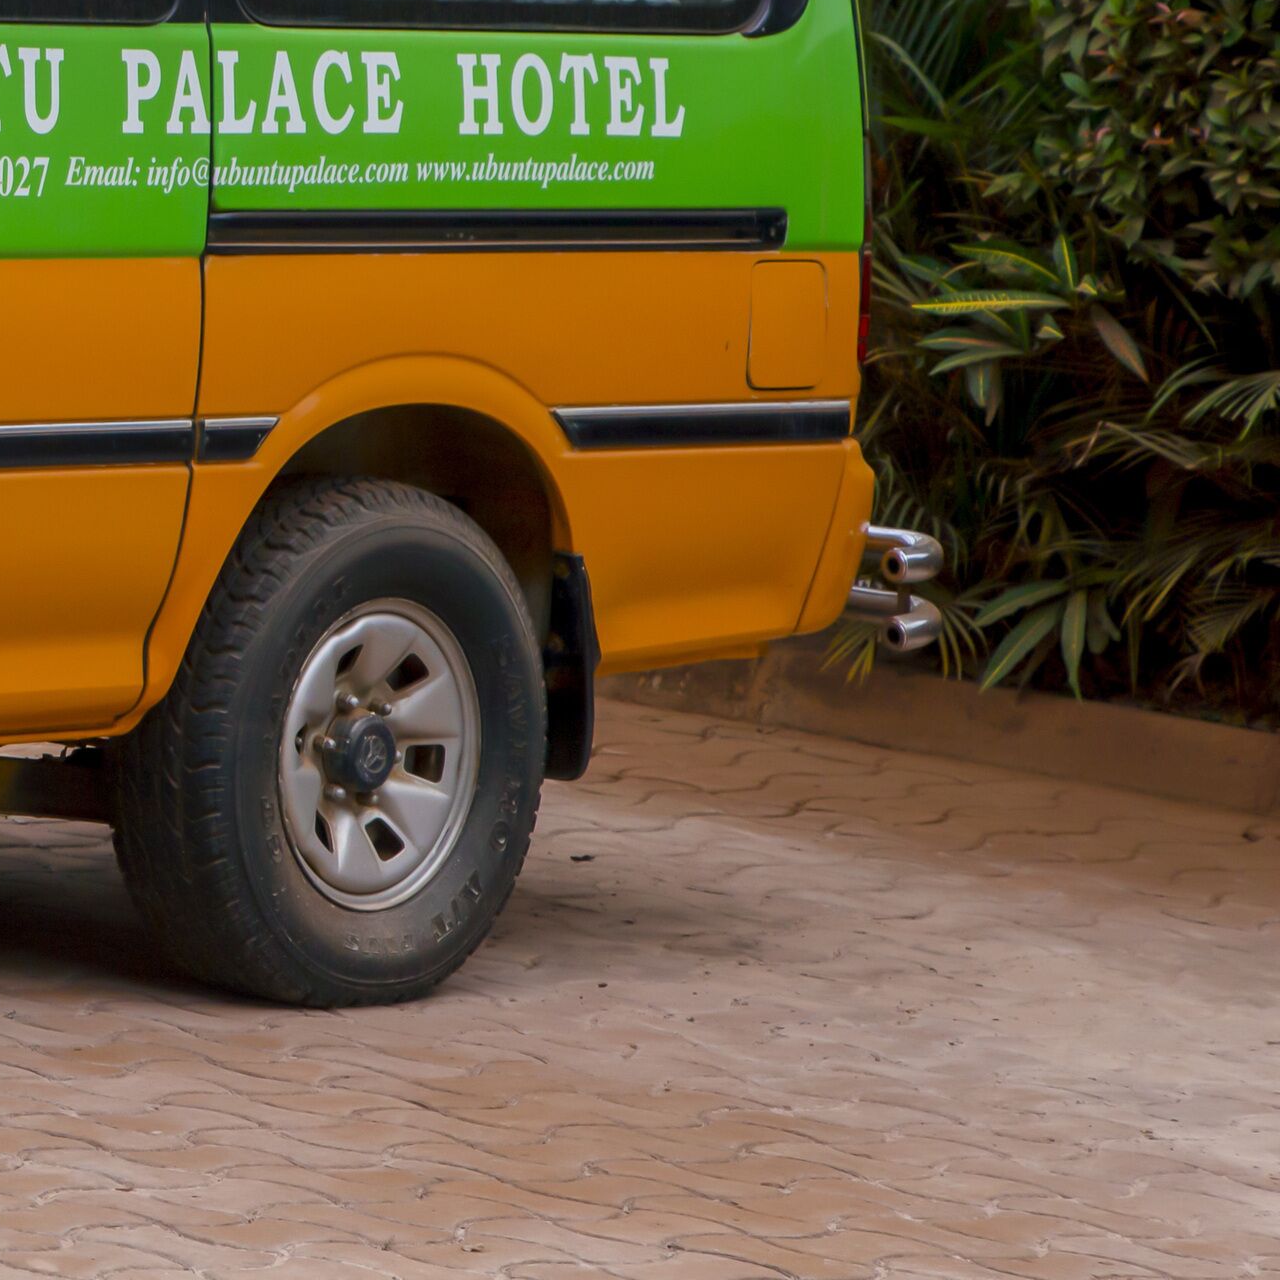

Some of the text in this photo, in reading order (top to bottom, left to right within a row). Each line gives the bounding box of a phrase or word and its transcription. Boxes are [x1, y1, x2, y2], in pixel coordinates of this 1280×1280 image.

[120, 49, 405, 135] PALACE
[456, 52, 686, 138] HOTEL
[64, 156, 142, 187] Email:
[146, 155, 409, 194] info@ubuntupalace.com
[415, 152, 655, 189] www.ubuntupalace.com
